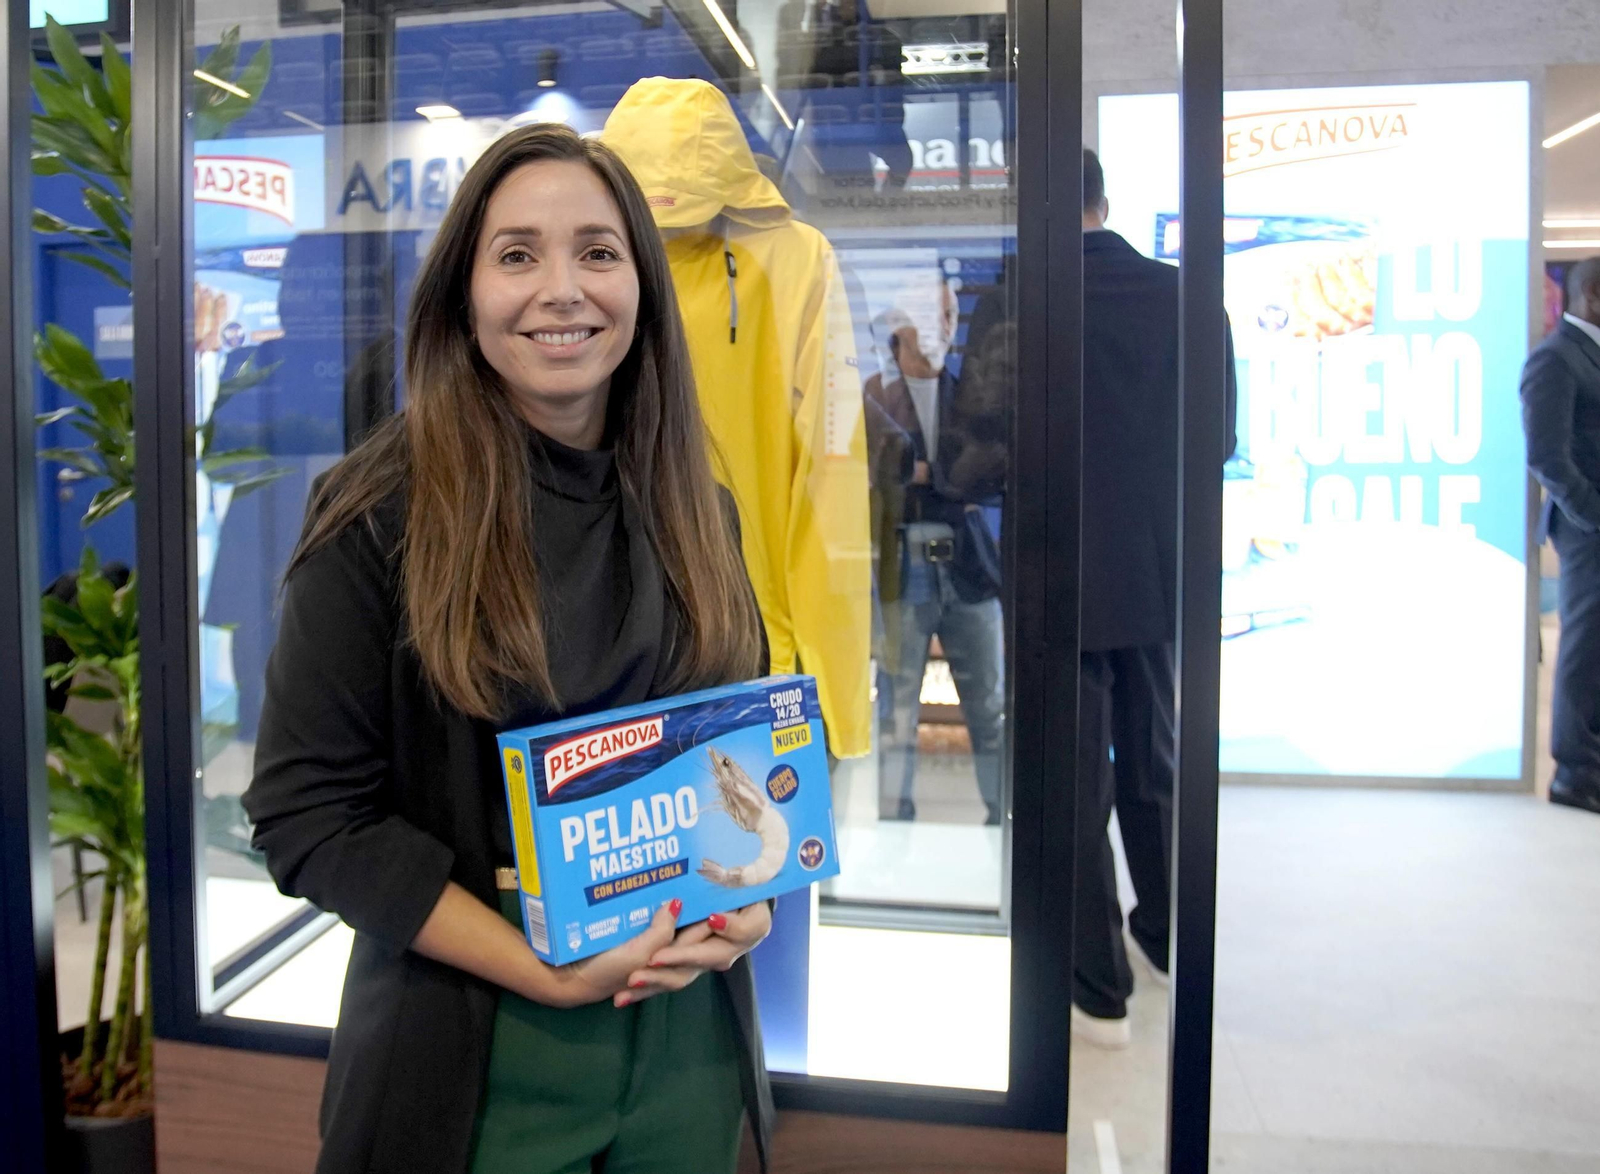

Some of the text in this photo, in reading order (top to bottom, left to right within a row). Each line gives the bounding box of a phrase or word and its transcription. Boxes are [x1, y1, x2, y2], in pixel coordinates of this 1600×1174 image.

[1224, 113, 1408, 163] ESCANOVA
[1249, 331, 1482, 466] BUENO
[769, 687, 803, 709] CRUDO
[775, 703, 801, 720] 14/20
[549, 723, 660, 781] PESCANOVA
[775, 728, 808, 749] NUEVO
[560, 786, 699, 863] PELADO
[589, 835, 680, 881] MAESTRO
[593, 863, 682, 900] CON CABEZA Y COLA
